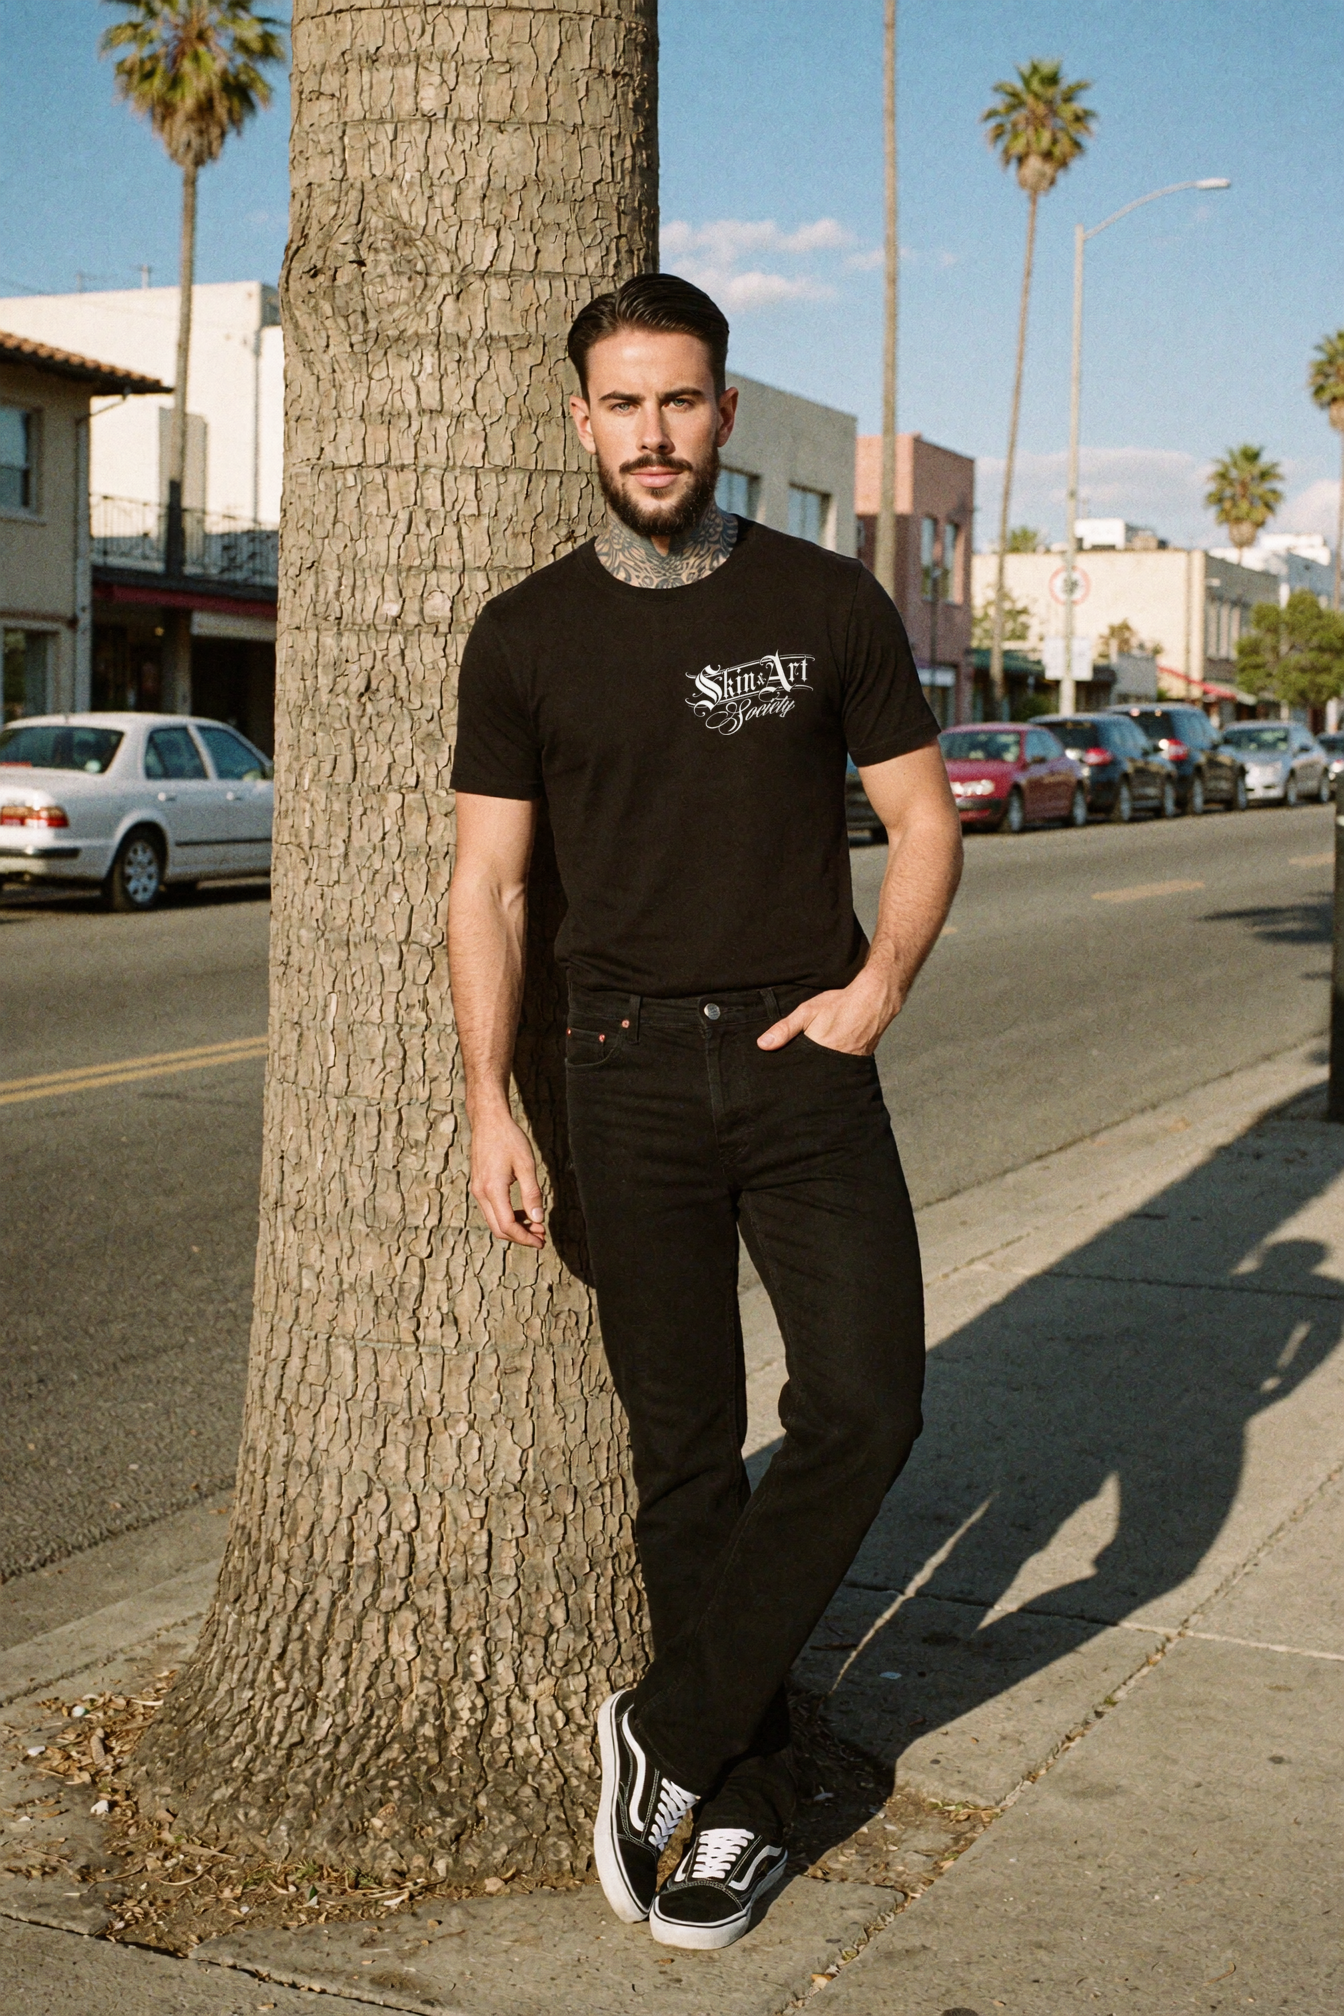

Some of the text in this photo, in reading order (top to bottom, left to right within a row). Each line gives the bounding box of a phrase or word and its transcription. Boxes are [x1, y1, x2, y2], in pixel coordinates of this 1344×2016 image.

[692, 649, 808, 716] Skin & Art
[705, 695, 796, 736] Society
